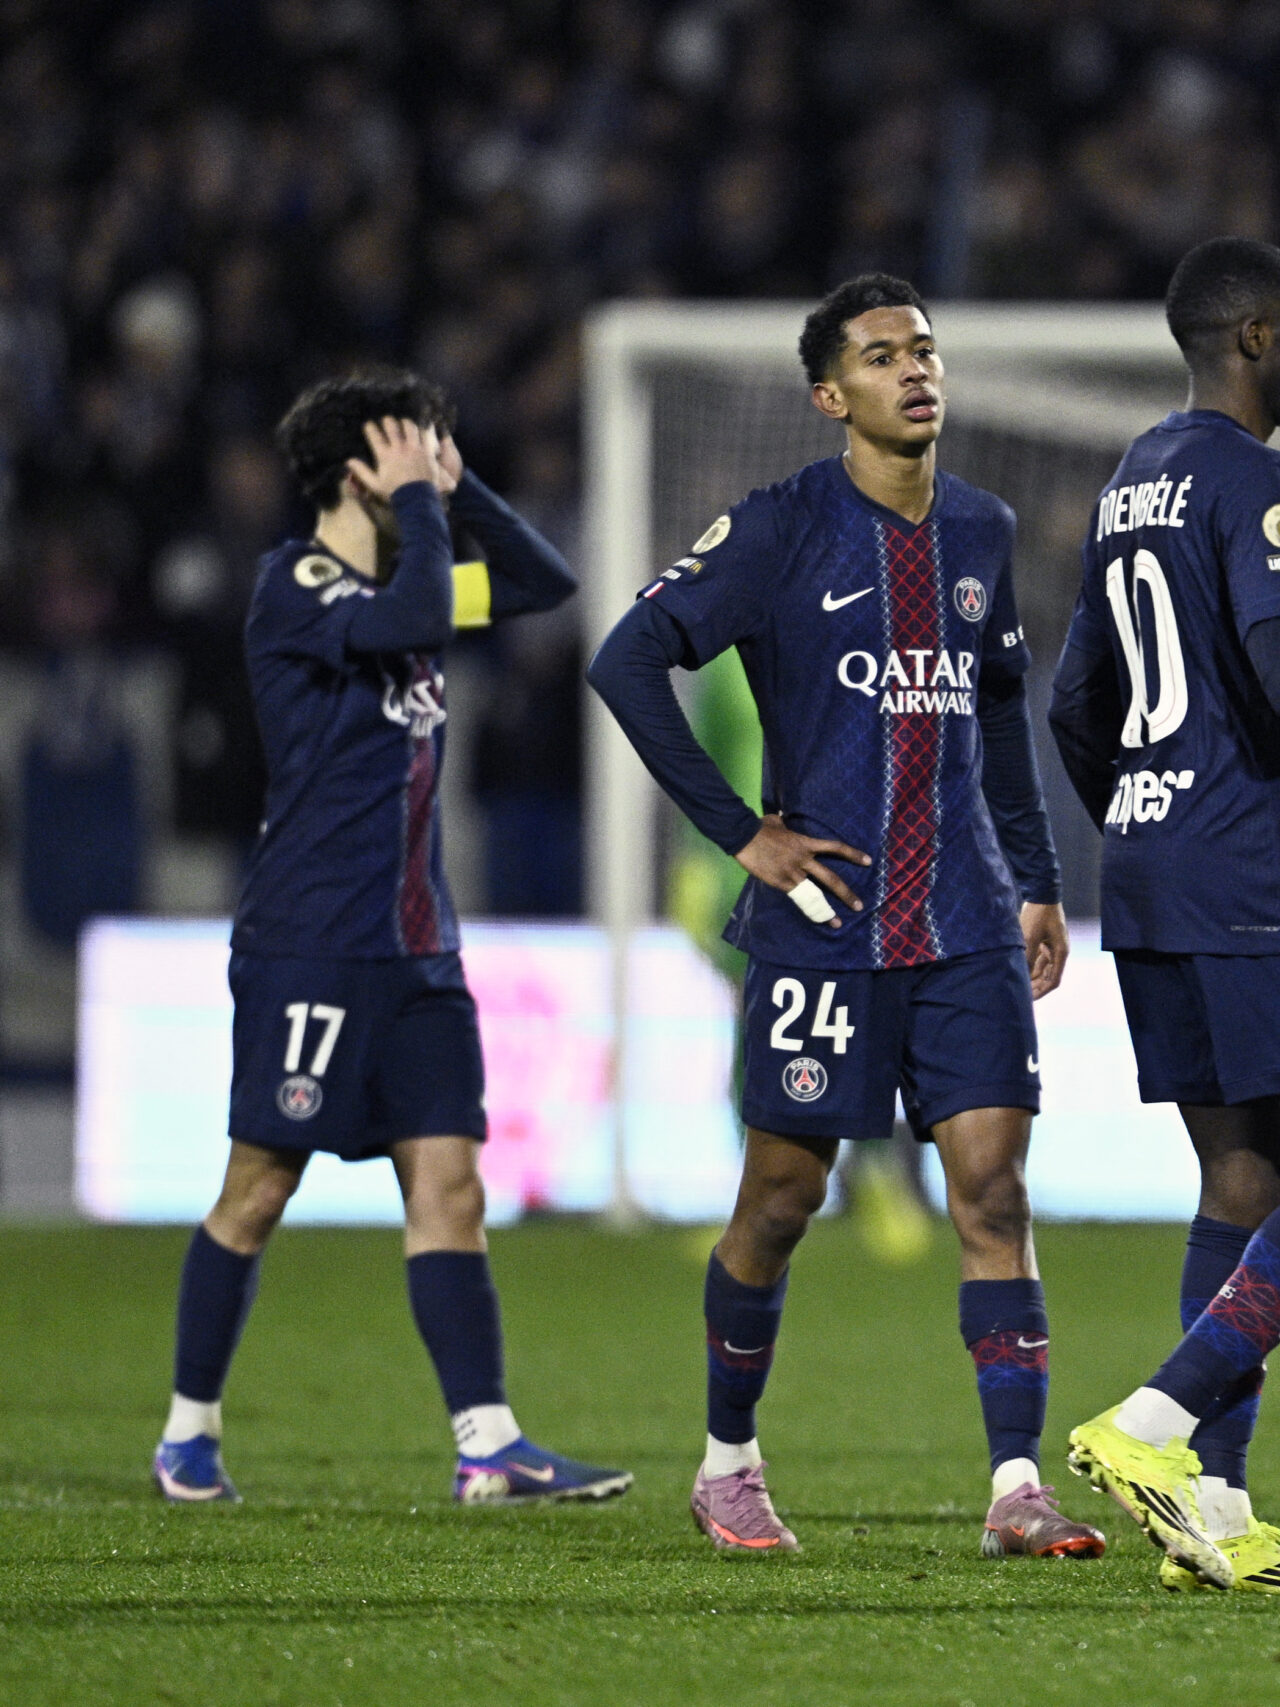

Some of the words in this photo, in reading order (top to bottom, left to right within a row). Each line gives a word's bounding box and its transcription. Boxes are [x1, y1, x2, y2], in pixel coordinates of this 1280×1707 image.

[837, 650, 974, 698] QATAR
[1105, 548, 1189, 749] 10
[879, 690, 973, 716] AIRWAYS
[284, 1003, 346, 1077] 17
[770, 977, 856, 1055] 24
